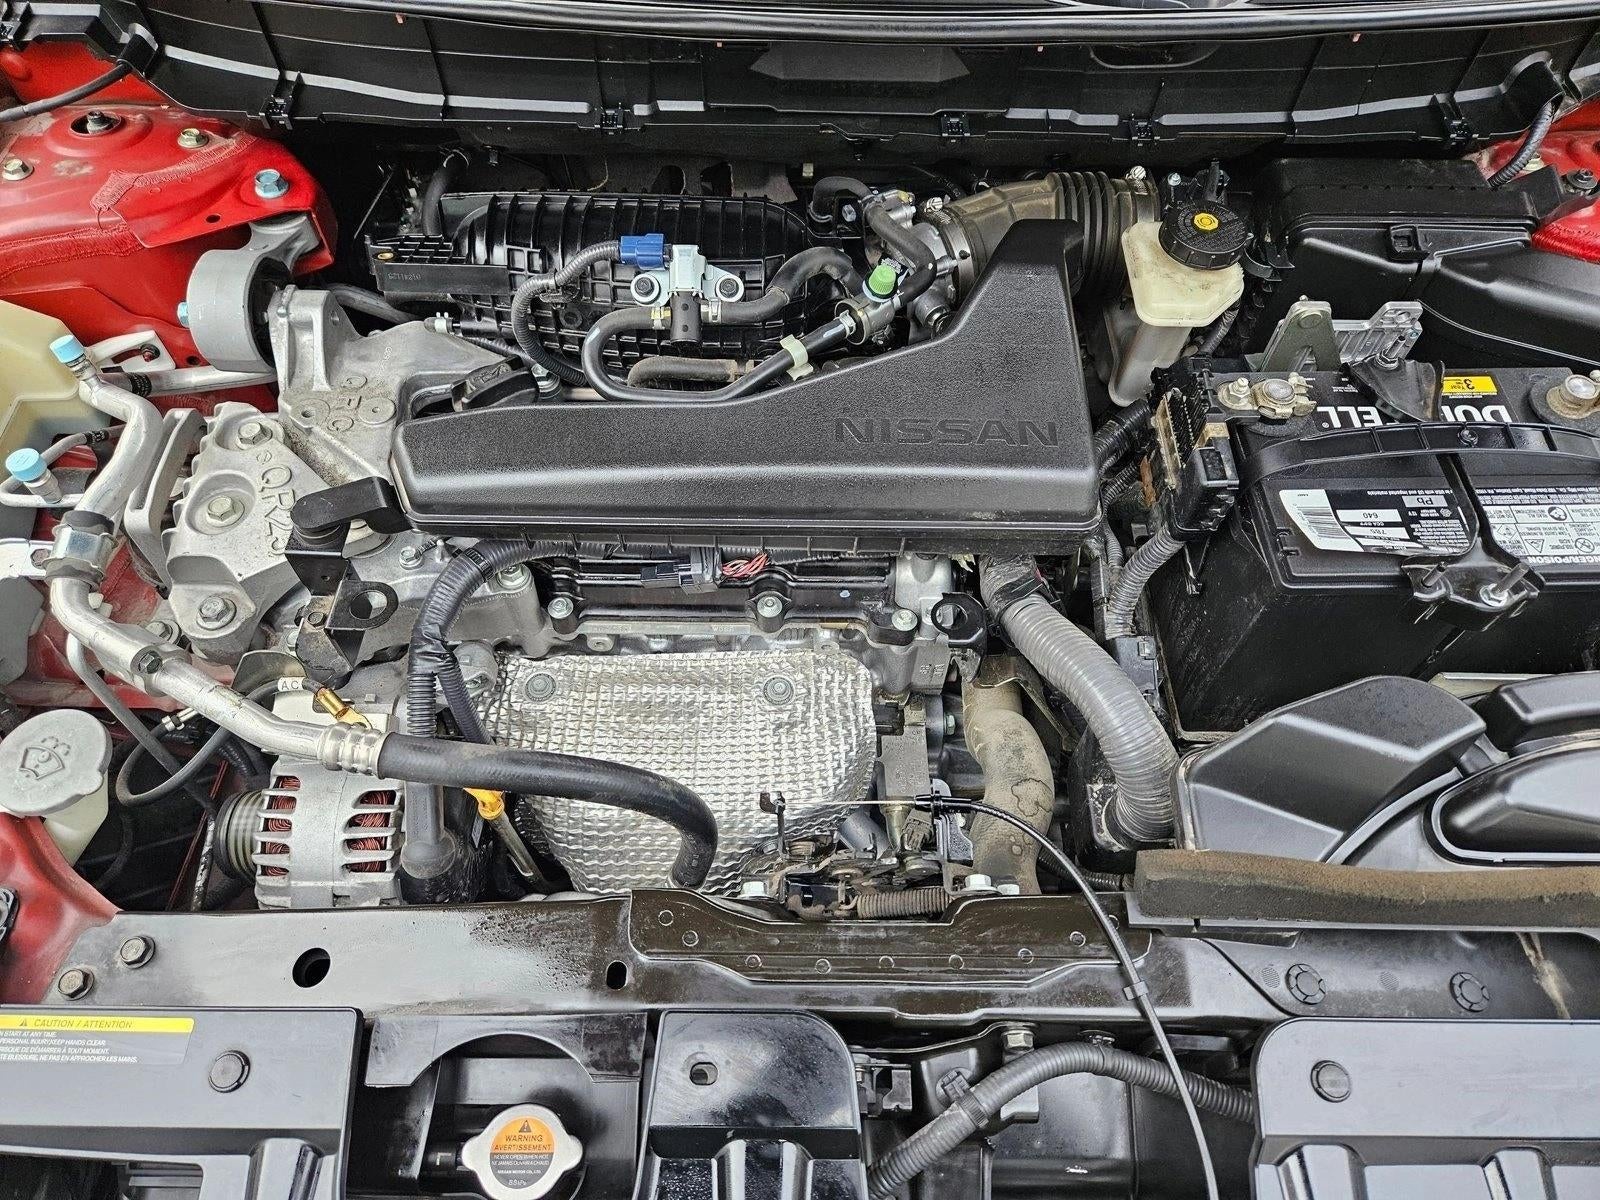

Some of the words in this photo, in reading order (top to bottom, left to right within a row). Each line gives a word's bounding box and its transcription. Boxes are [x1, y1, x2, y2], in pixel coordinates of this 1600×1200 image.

[1463, 379, 1475, 389] 3
[835, 417, 1058, 448] NISSAN
[1416, 497, 1433, 505] Pb
[34, 1019, 75, 1028] CAUTION
[83, 1020, 133, 1028] ATTENTION
[505, 1134, 543, 1142] WARNING
